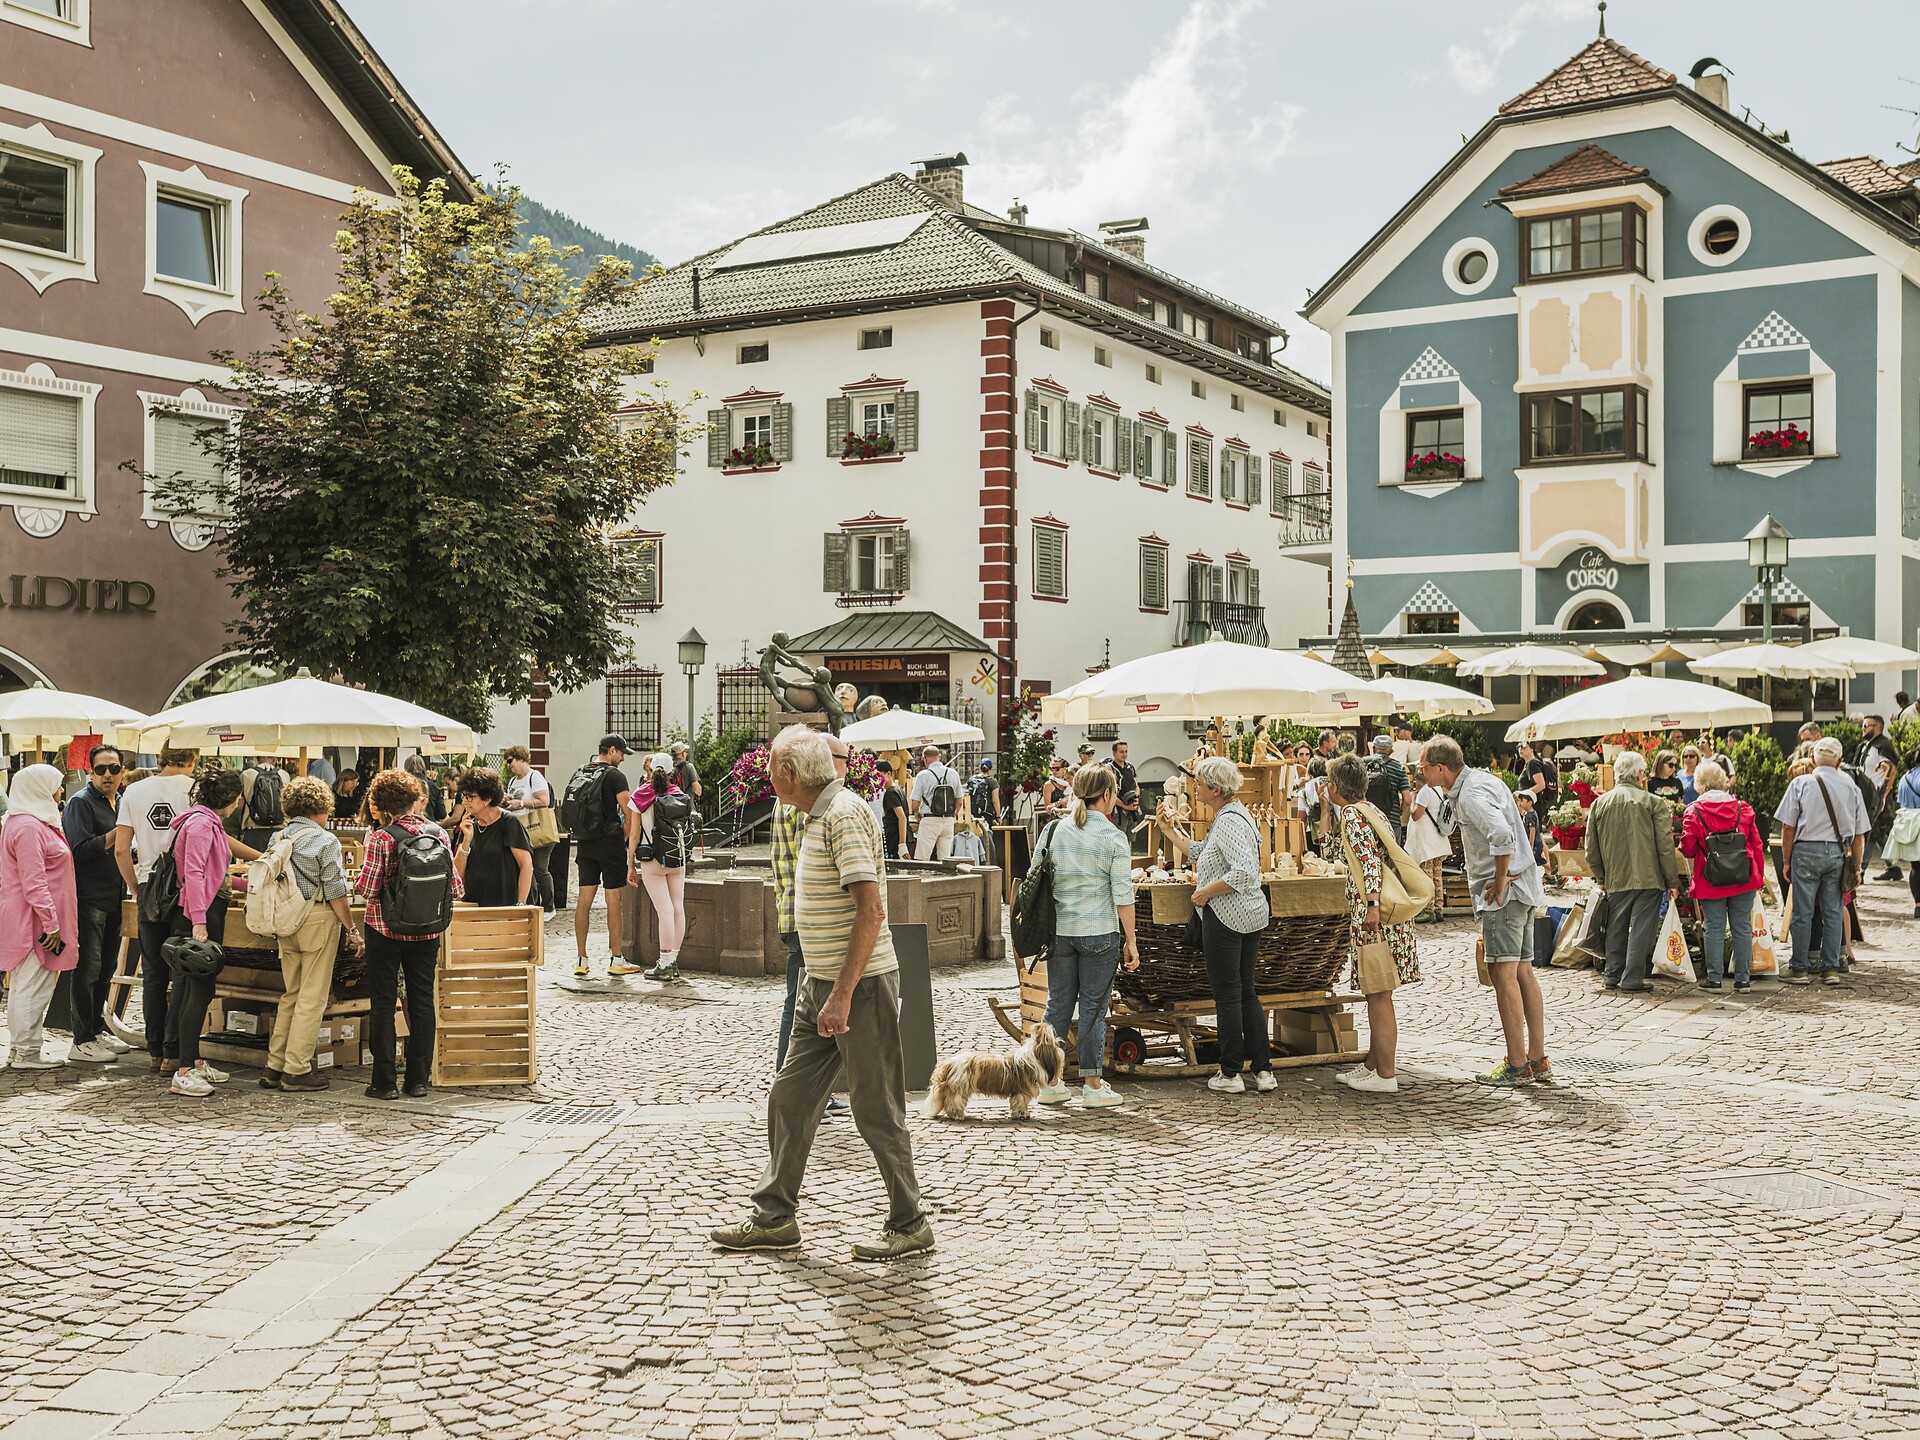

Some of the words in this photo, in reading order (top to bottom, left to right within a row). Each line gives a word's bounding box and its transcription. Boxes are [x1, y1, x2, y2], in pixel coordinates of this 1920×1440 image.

[1566, 567, 1619, 591] CORSO
[0, 574, 157, 613] LDIER
[828, 658, 903, 671] ATHESIA
[1751, 928, 1768, 939] NAD
